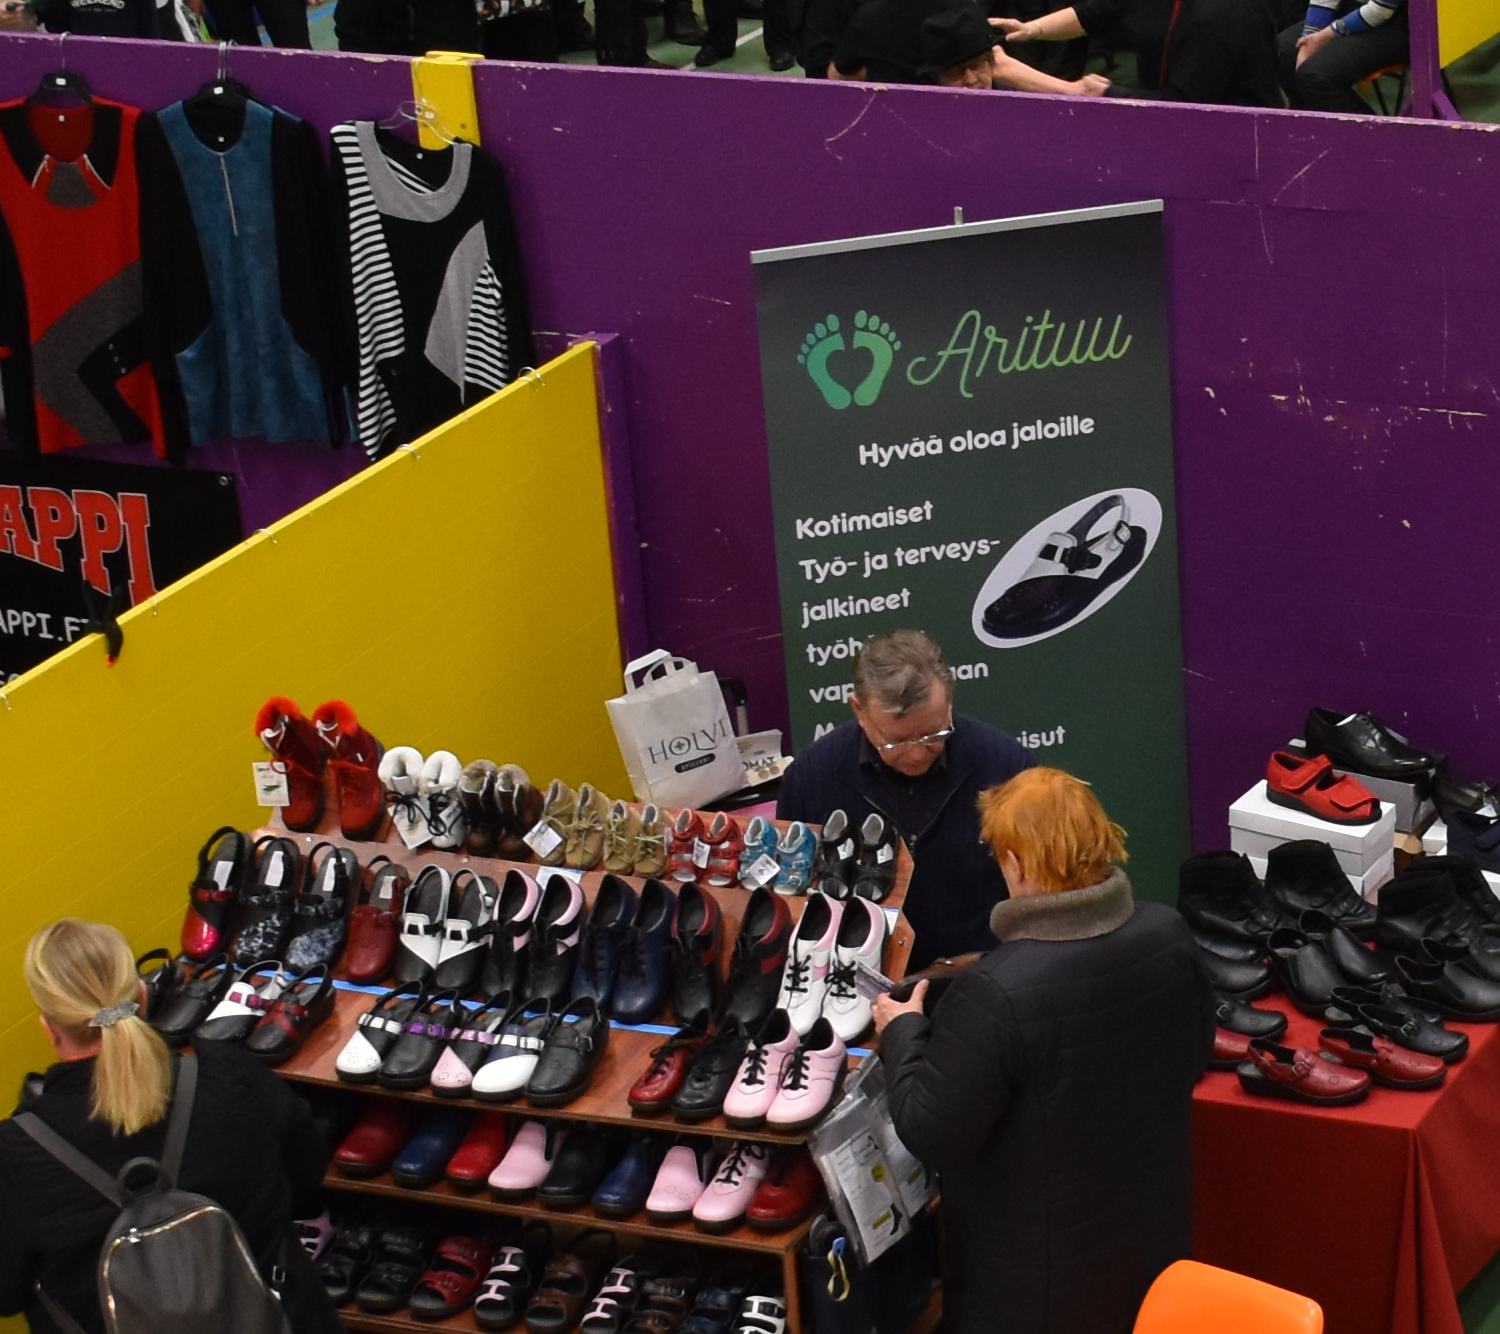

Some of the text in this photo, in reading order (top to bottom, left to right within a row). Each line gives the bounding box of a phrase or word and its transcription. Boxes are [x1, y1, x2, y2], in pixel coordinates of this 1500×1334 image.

[906, 309, 1133, 398] Arituu
[859, 414, 1095, 467] Hyvää oloa jaloille
[796, 500, 934, 540] Kotimaiset
[799, 537, 1002, 584] Työ- ja terveys-
[801, 587, 911, 629] jalkineet
[648, 719, 727, 765] HOLVI
